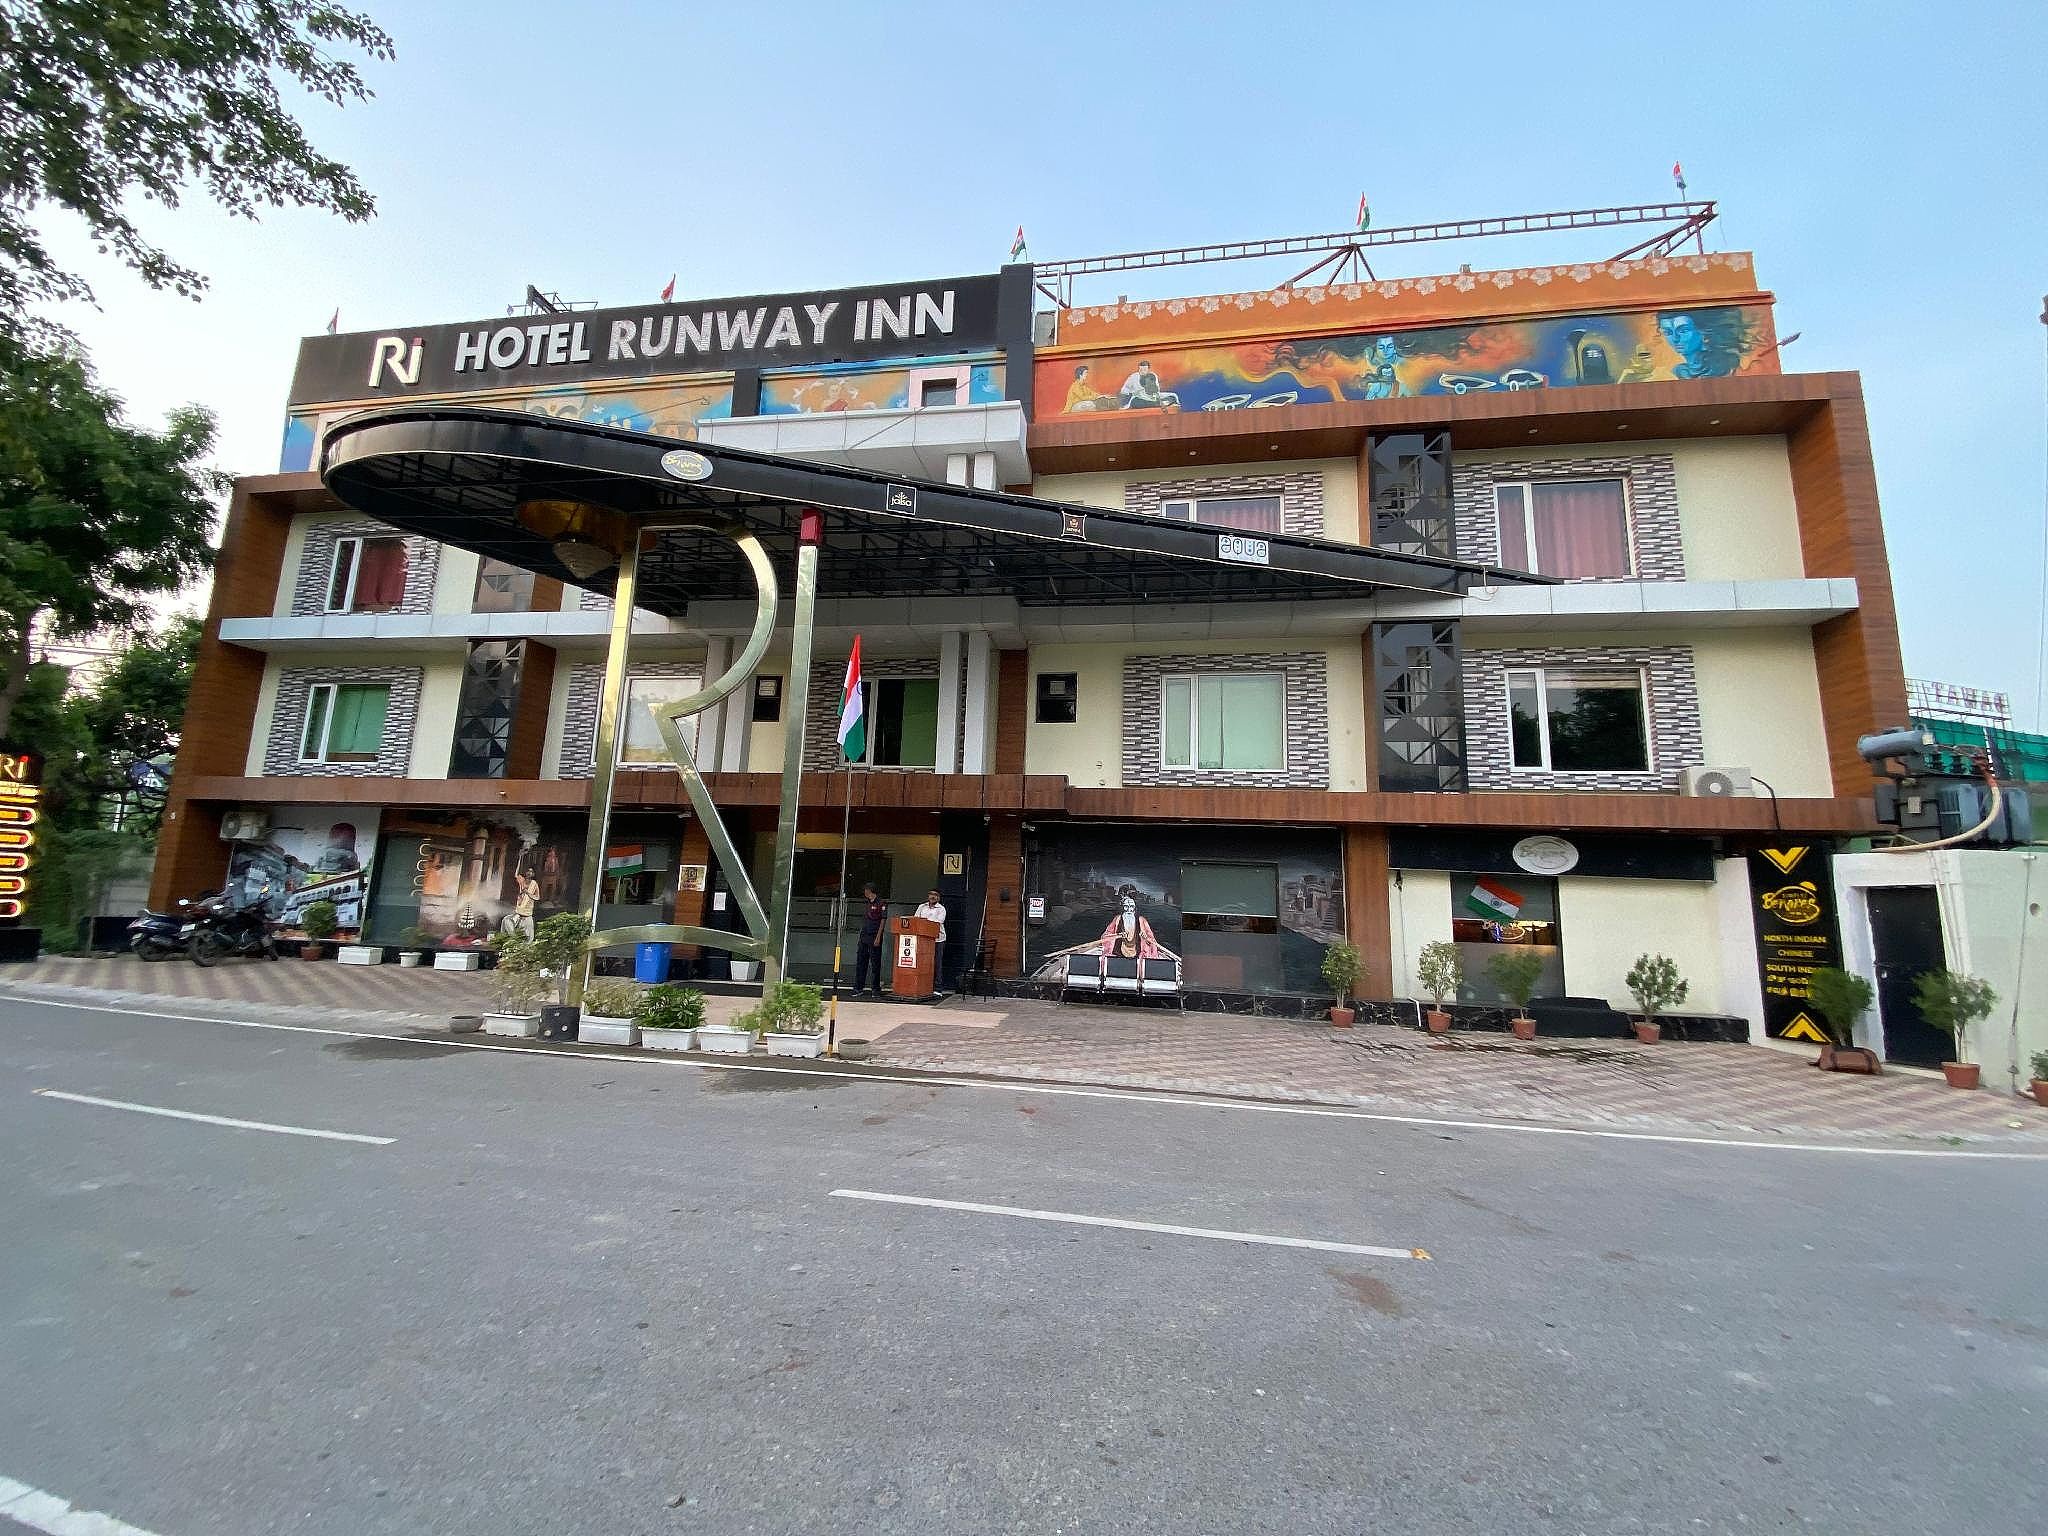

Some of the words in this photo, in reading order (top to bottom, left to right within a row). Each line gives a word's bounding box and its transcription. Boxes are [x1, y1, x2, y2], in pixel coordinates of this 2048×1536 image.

[455, 322, 591, 373] HOTEL
[608, 302, 839, 360] RUNWAY
[854, 290, 955, 342] INN
[1763, 934, 1792, 942] NORTH
[1794, 935, 1827, 943] INDIAN
[1777, 949, 1814, 957] CHINESE
[1766, 964, 1796, 972] SOUTH
